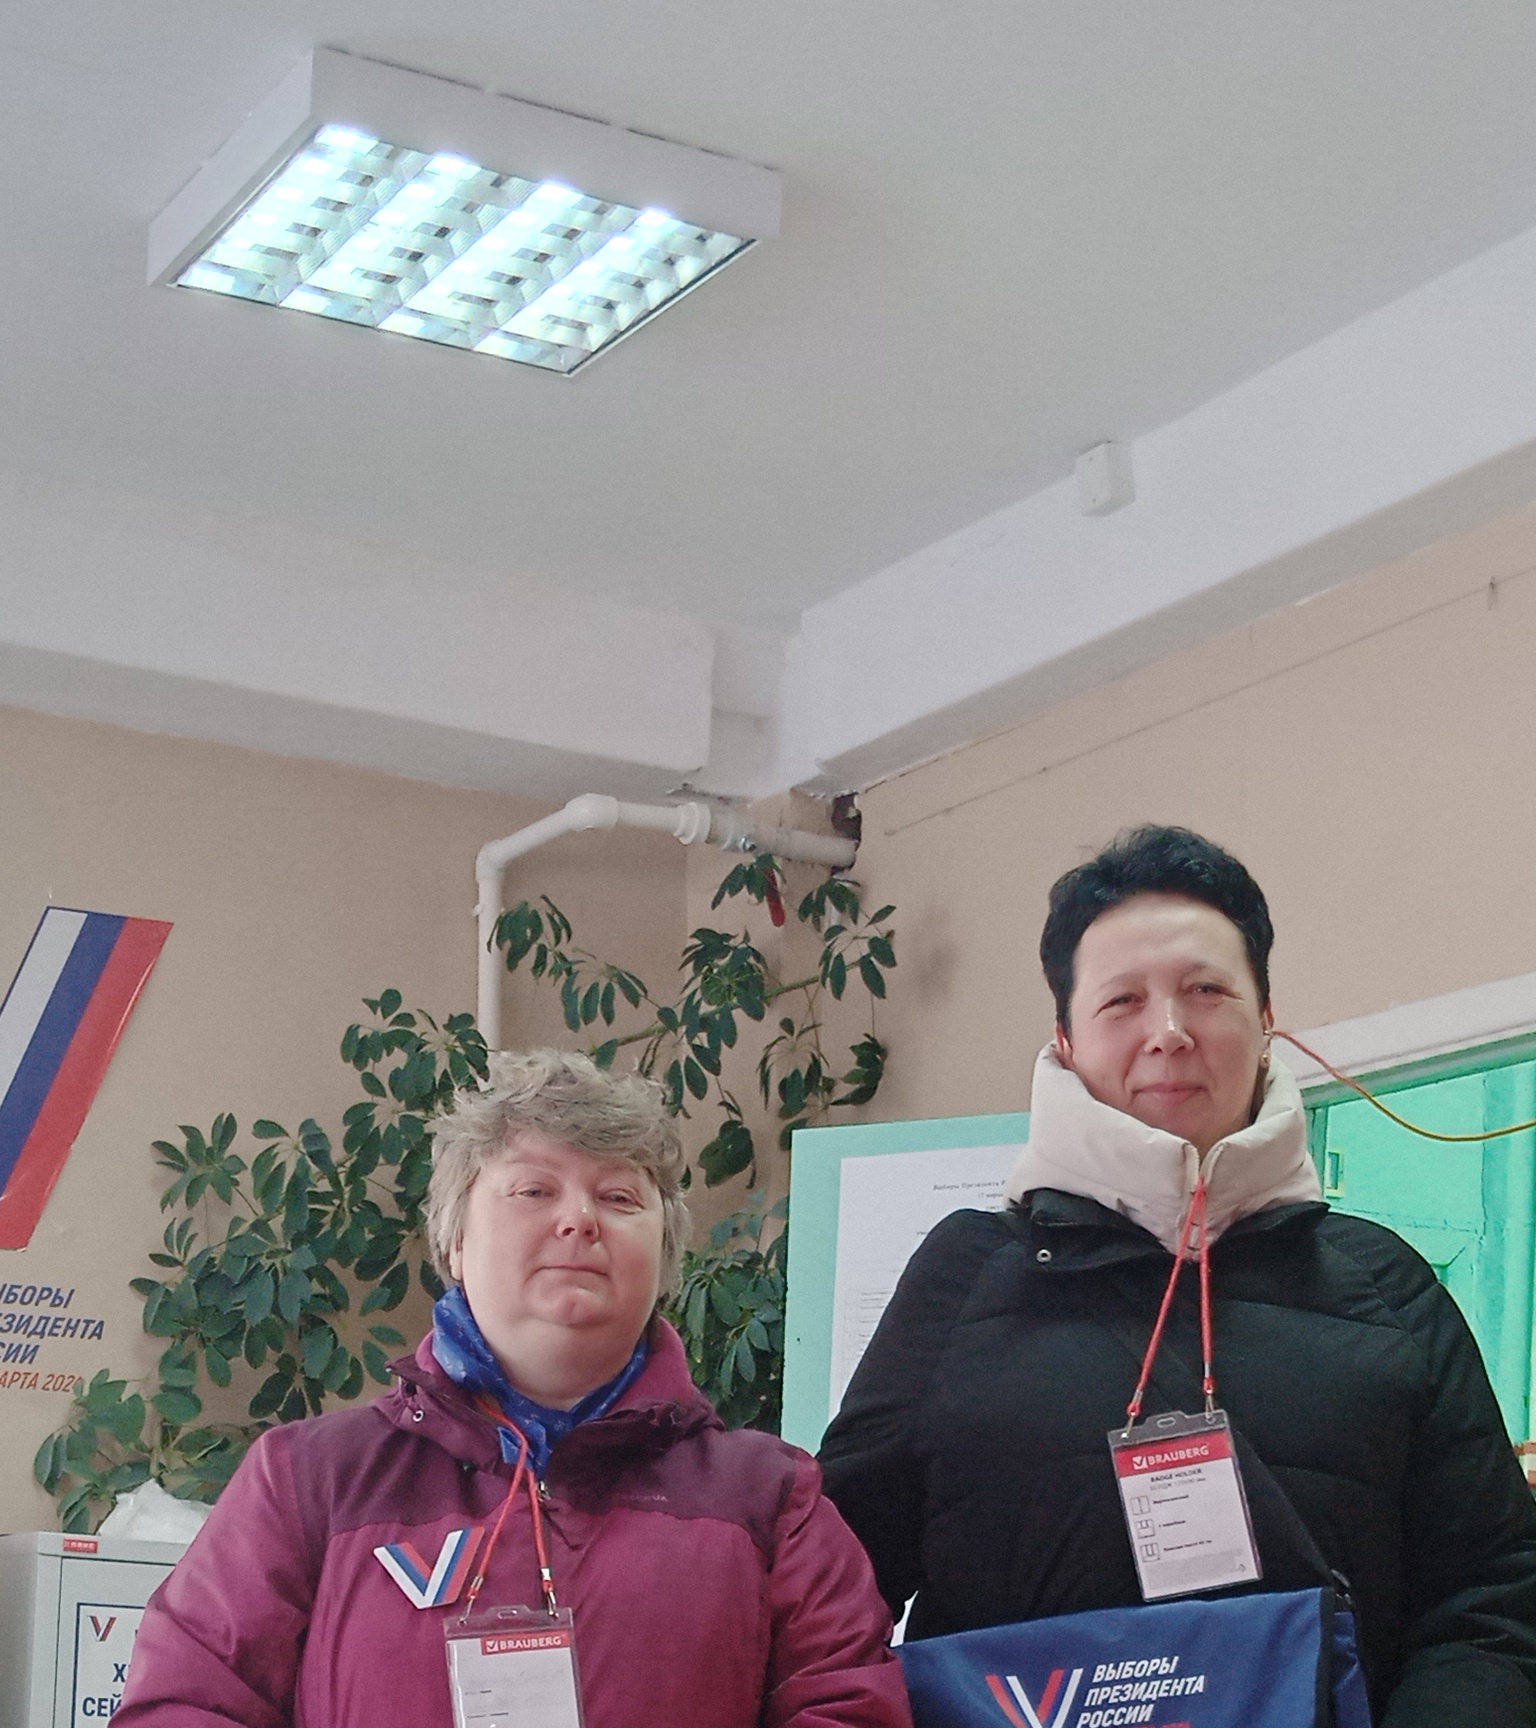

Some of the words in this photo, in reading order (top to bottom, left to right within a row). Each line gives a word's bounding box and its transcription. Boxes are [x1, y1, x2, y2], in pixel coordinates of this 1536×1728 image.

[1147, 1445, 1210, 1465] BRAUBERG
[500, 1635, 562, 1650] BRAUBERG
[1092, 1656, 1179, 1683] ВЫБОРЫ
[1084, 1675, 1206, 1707] ПРЕЗИДЕНТА
